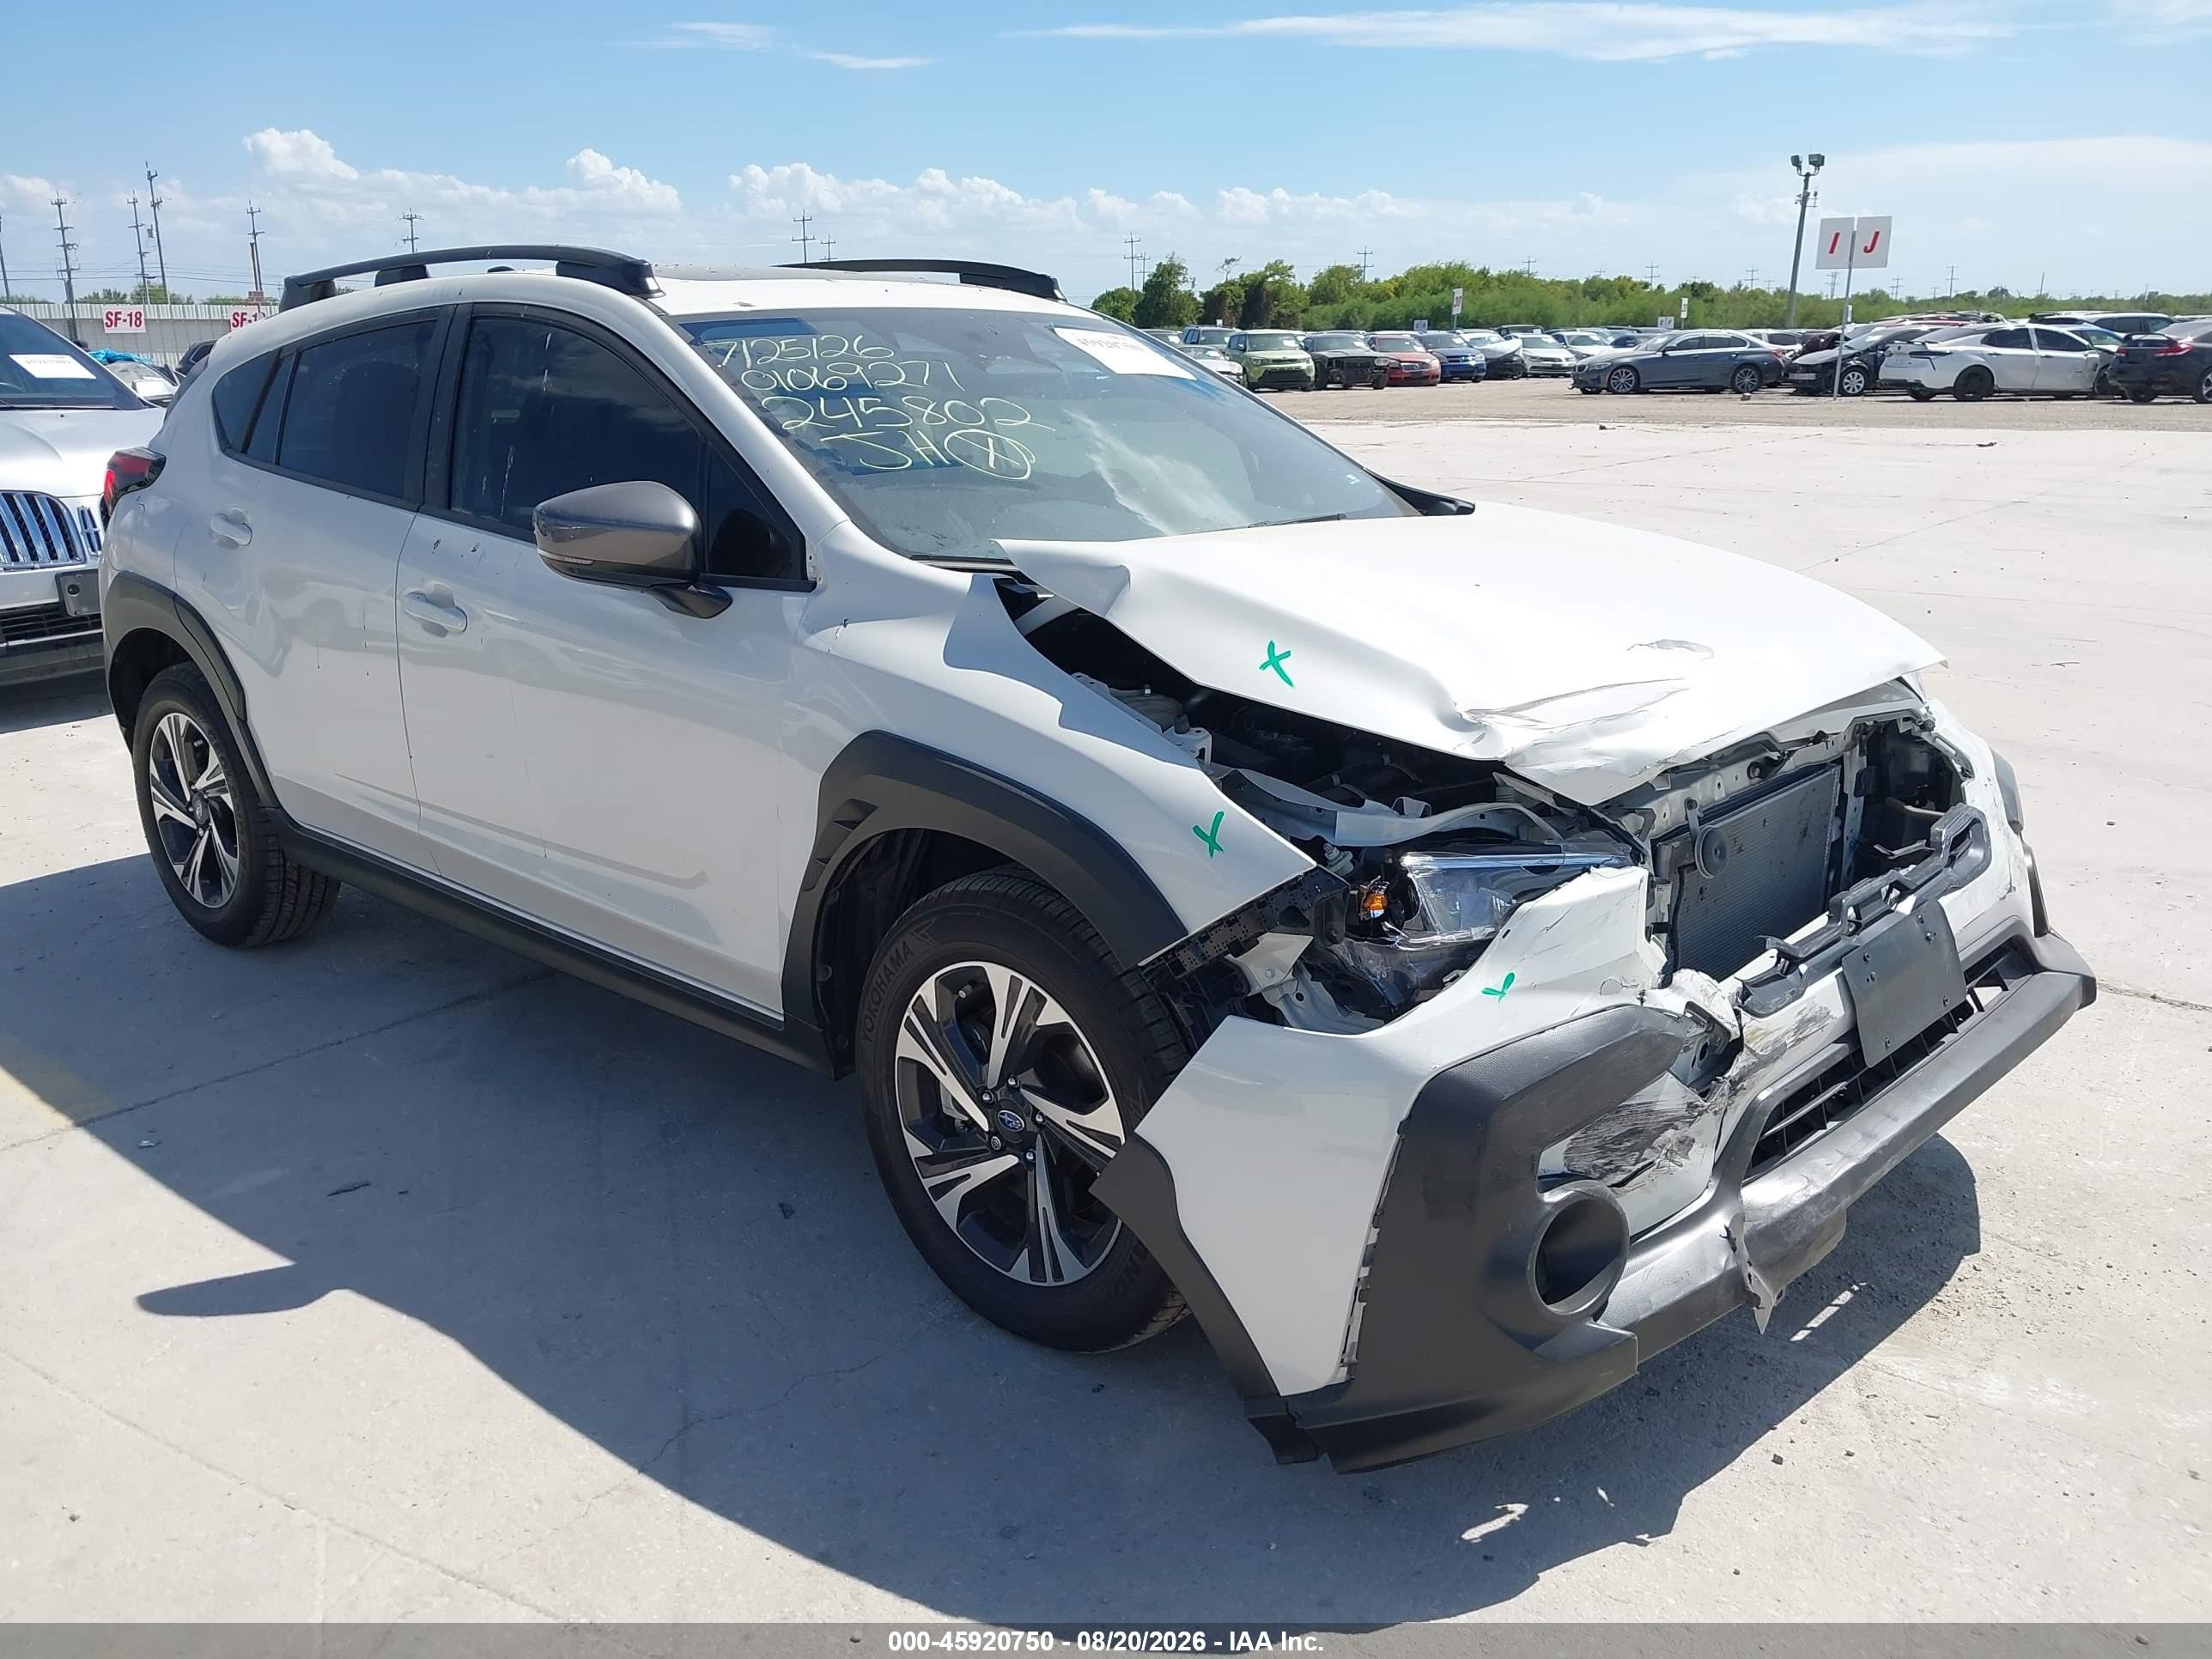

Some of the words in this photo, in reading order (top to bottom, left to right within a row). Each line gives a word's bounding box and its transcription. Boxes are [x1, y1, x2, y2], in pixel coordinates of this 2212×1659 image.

[1828, 231, 1840, 254] I
[1863, 230, 1881, 254] J
[105, 310, 143, 328] SF-18
[761, 396, 1057, 431] 245802
[861, 940, 914, 1043] YOKOHAMA
